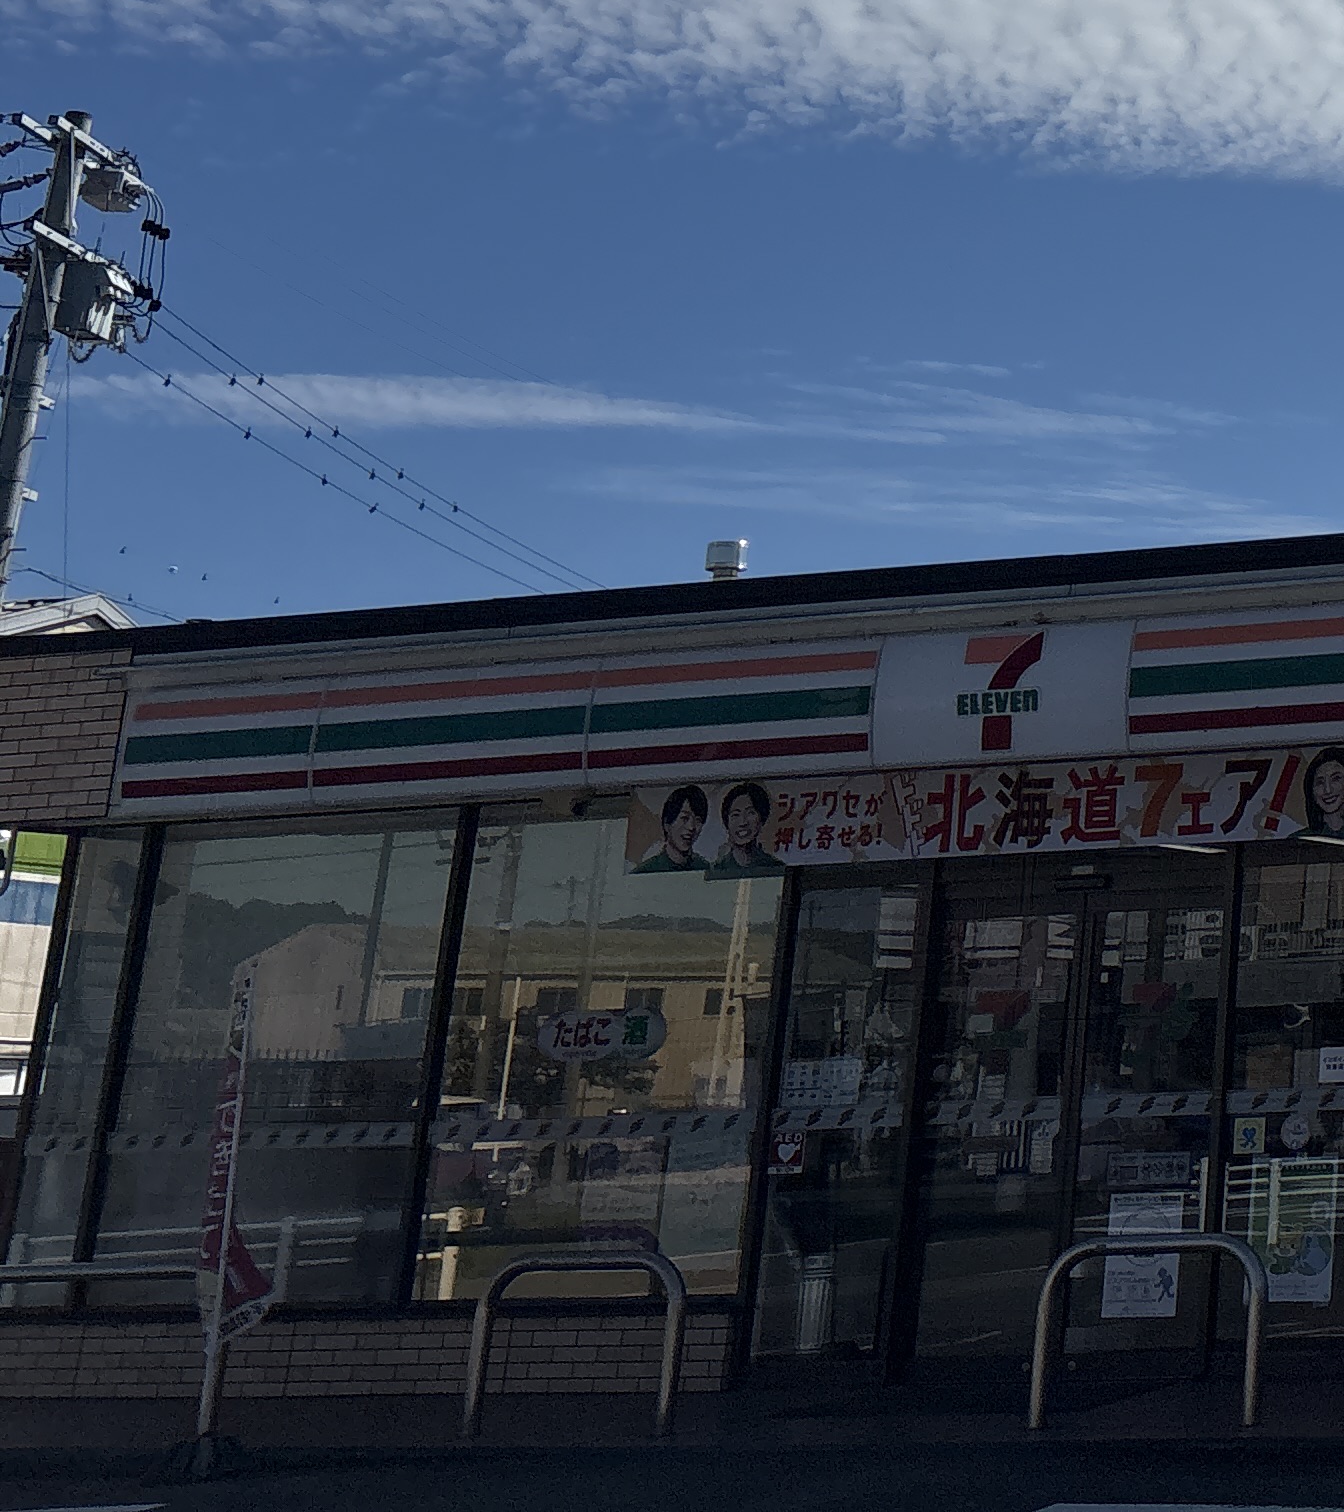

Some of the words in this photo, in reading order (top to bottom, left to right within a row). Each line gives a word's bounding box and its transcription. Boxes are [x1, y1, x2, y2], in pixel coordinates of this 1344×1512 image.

[778, 789, 888, 822] シアワセが
[553, 1016, 612, 1048] たばこ
[774, 1133, 803, 1143] AED
